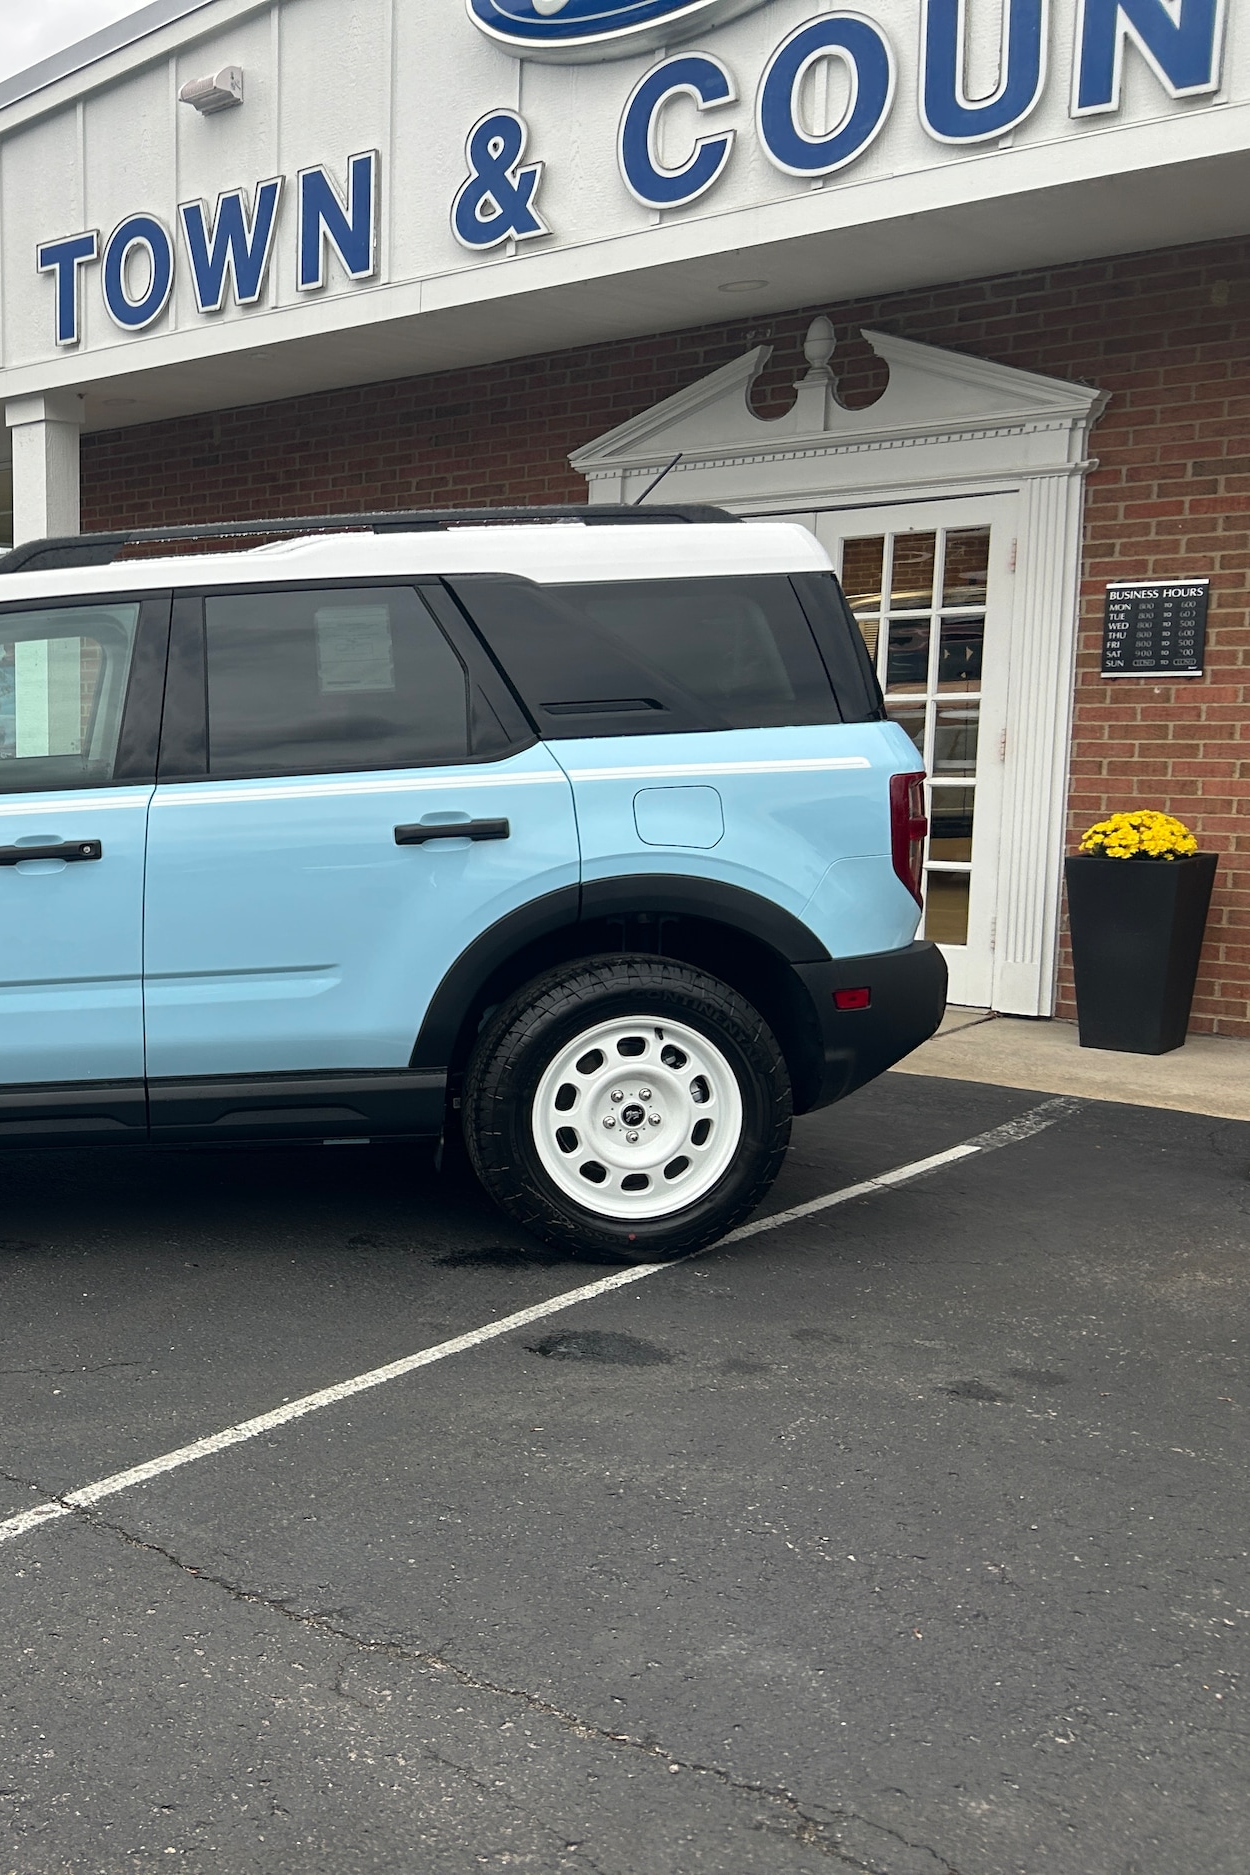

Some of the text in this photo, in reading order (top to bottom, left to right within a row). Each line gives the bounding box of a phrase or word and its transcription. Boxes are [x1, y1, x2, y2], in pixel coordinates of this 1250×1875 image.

[36, 0, 1222, 348] TOWN & COUN
[1110, 587, 1204, 600] BUSINESS HOURS
[1109, 603, 1132, 611] MON
[1108, 622, 1130, 630] WED
[1106, 641, 1120, 649] FRI
[1106, 650, 1122, 658] SAT
[1105, 659, 1125, 667] SUN
